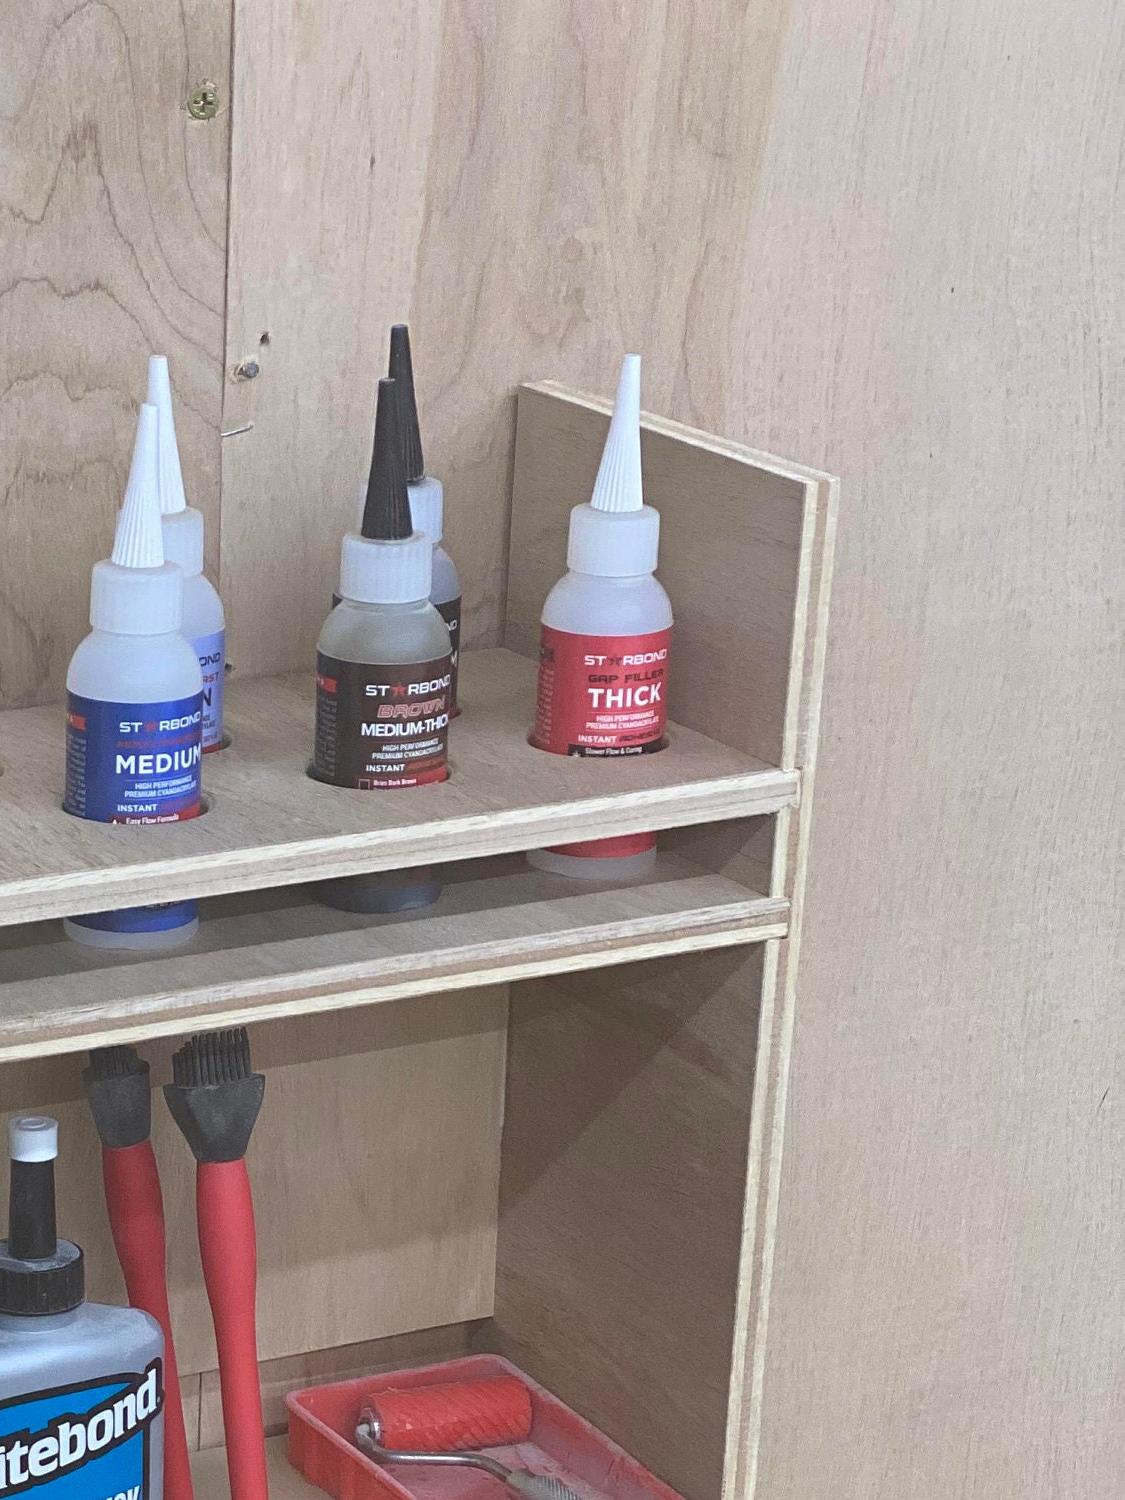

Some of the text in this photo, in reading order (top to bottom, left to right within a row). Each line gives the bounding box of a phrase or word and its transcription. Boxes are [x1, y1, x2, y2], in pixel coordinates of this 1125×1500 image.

[587, 681, 662, 708] THICK
[377, 695, 446, 719] BROWN
[578, 734, 617, 743] INSTANT
[116, 742, 202, 774] MEDIUM
[366, 763, 406, 773] INSTANT
[117, 803, 158, 813] INSTANT
